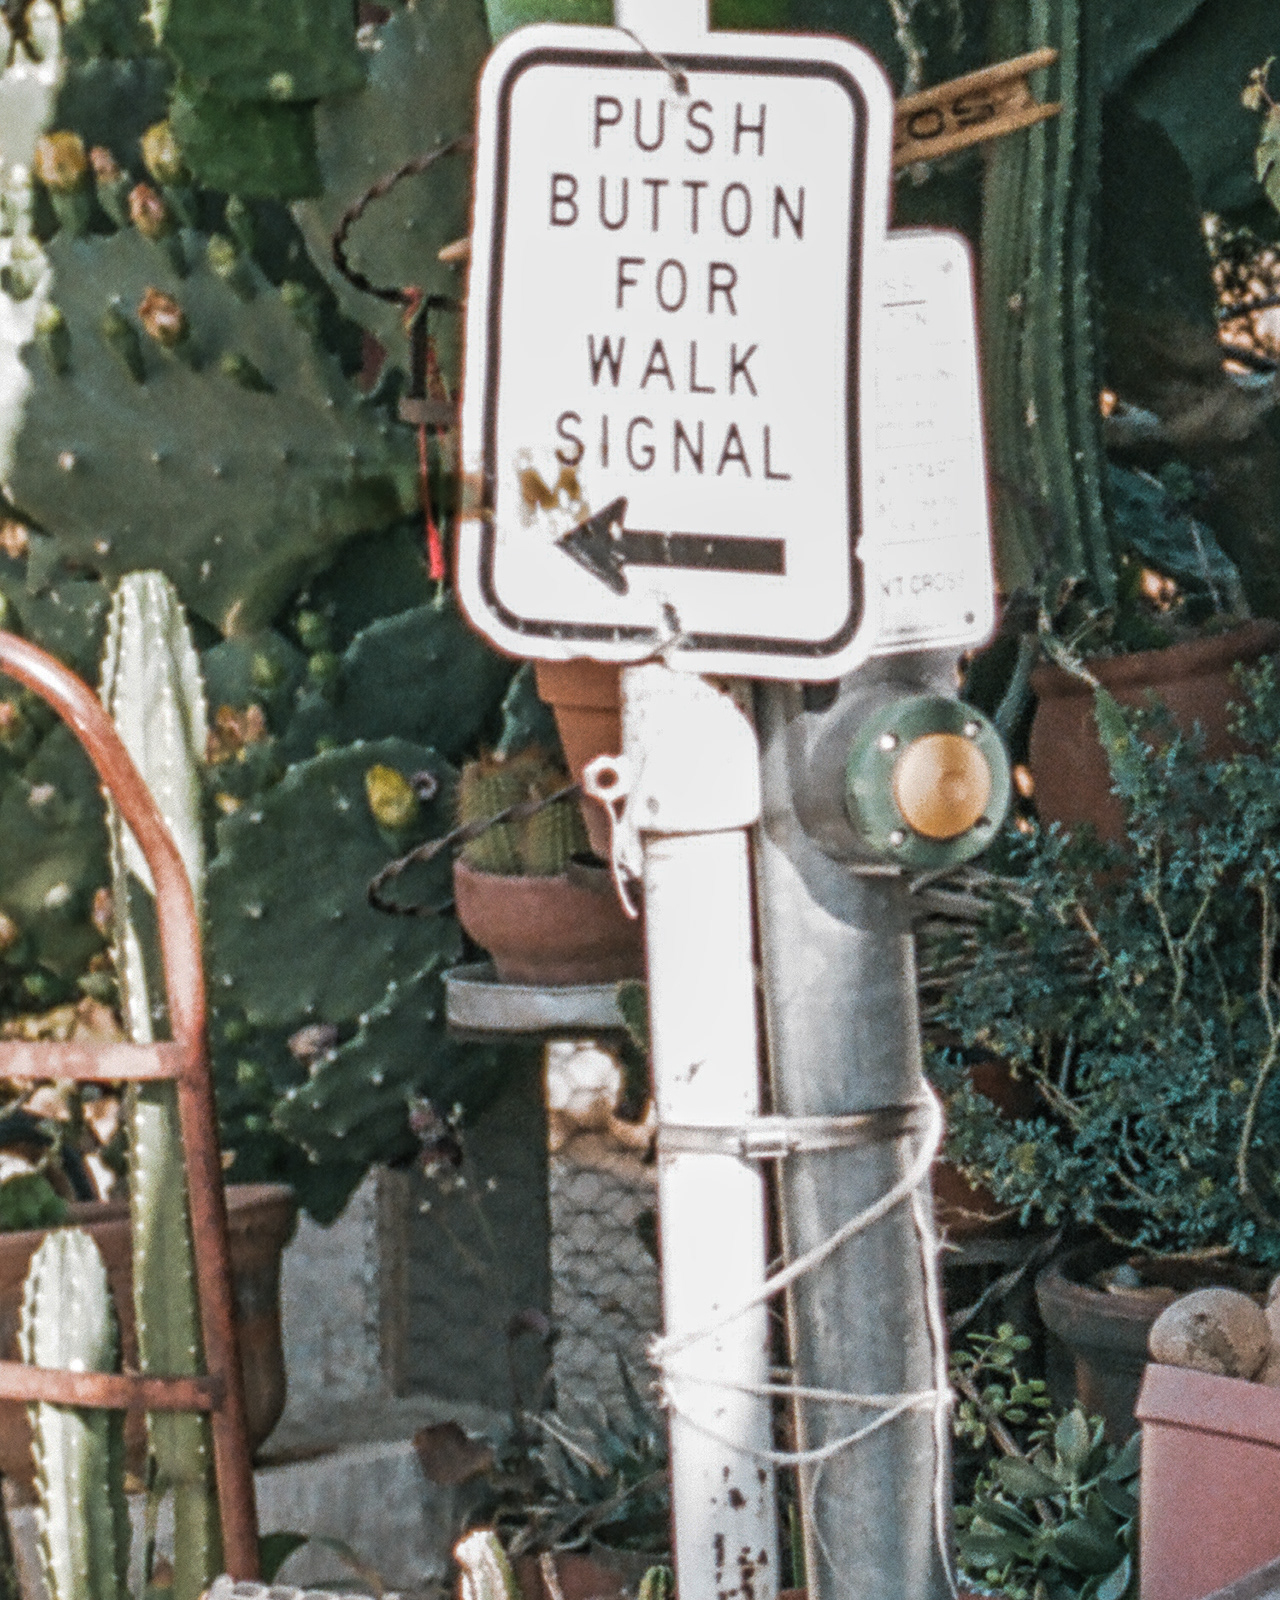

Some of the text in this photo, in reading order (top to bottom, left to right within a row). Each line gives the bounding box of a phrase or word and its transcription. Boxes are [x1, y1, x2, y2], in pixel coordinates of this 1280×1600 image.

[595, 97, 765, 154] PUSH
[551, 174, 804, 239] BUTTON
[618, 258, 736, 314] FOR
[588, 336, 756, 395] WALK
[555, 411, 791, 480] SIGNAL
